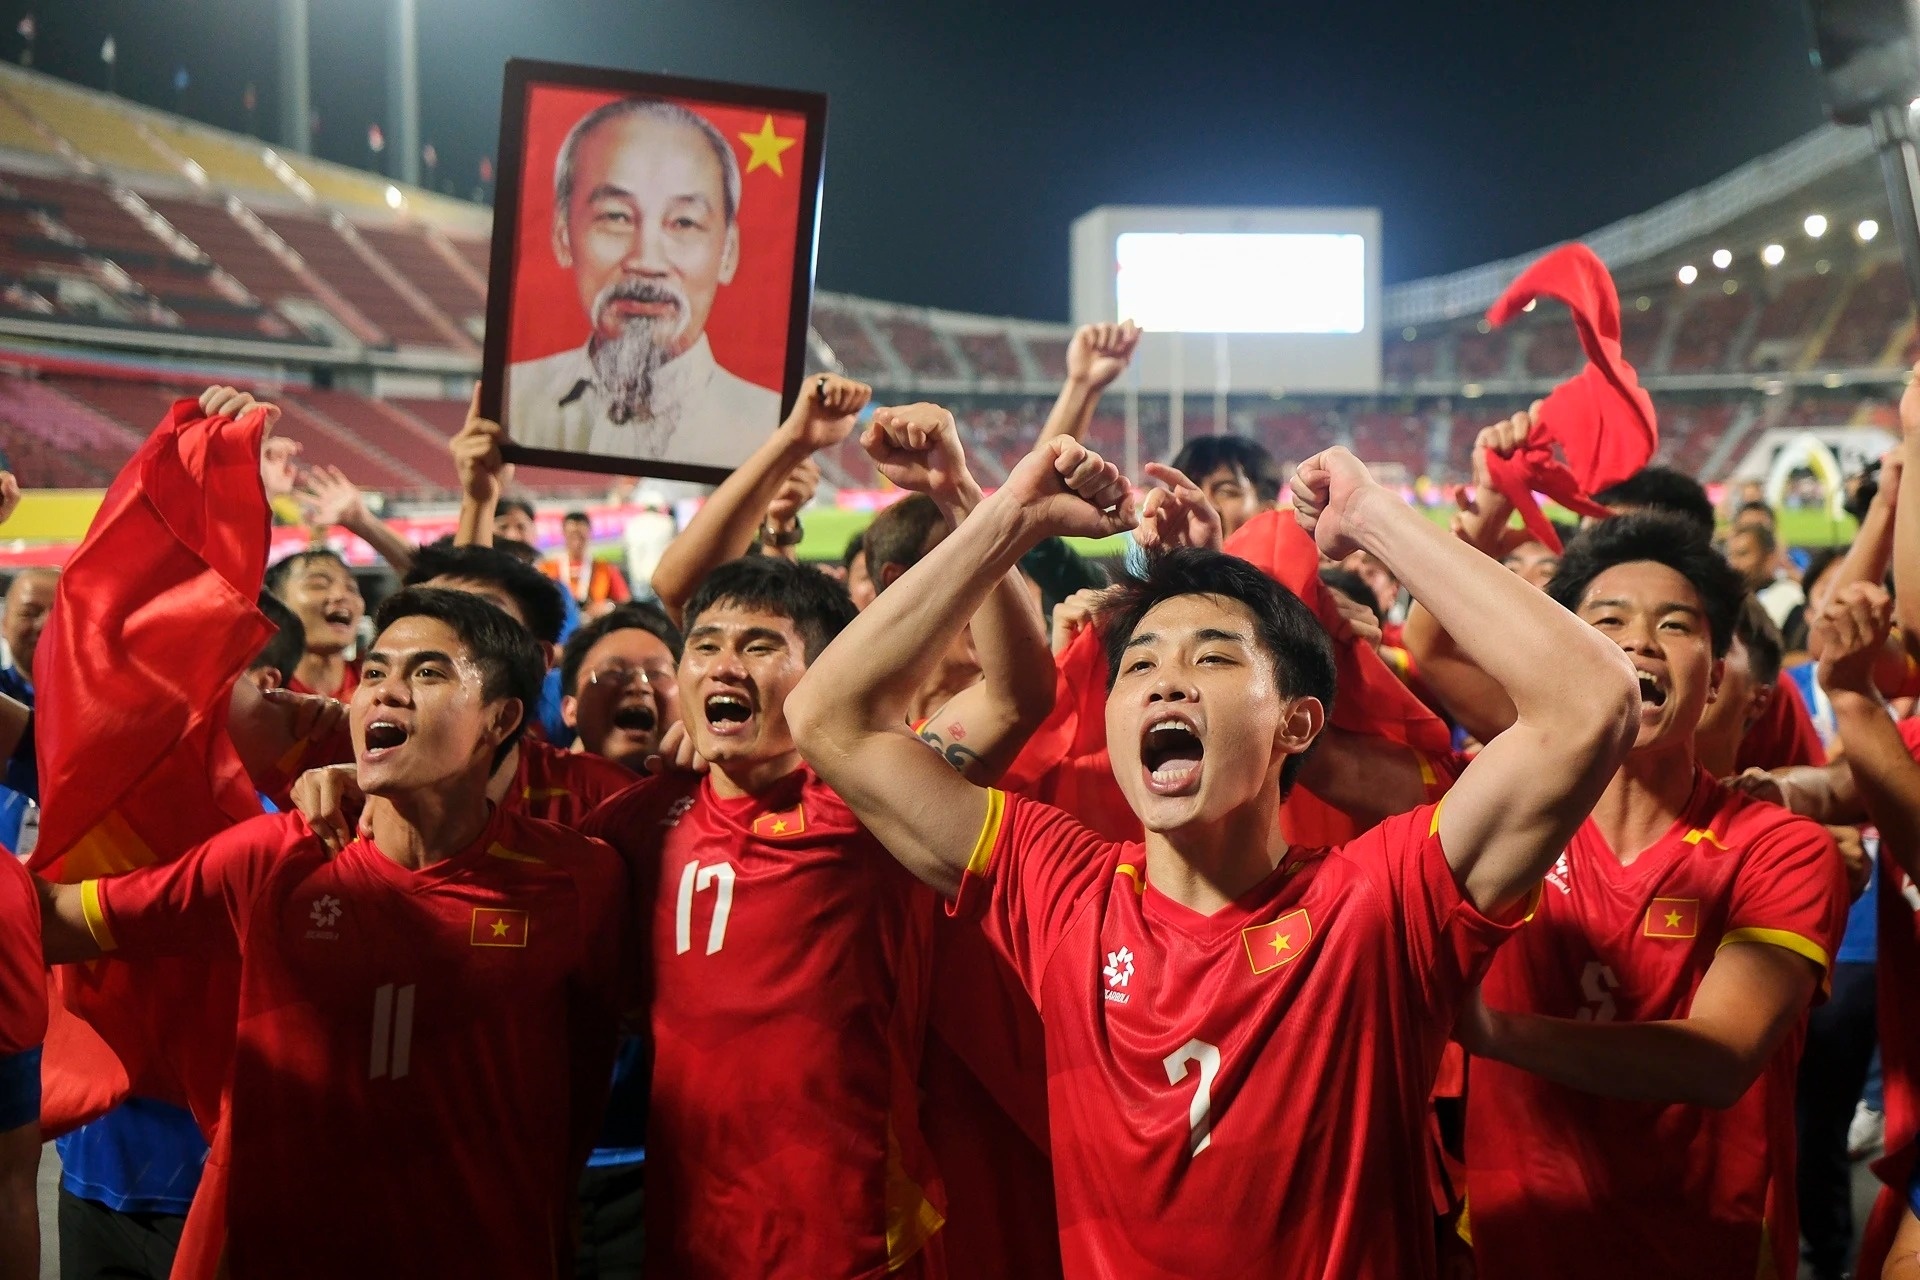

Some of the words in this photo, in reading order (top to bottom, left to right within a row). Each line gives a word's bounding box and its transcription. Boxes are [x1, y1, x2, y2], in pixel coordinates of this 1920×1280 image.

[676, 860, 736, 956] 17
[369, 982, 416, 1081] 11
[1162, 1037, 1221, 1158] 7
